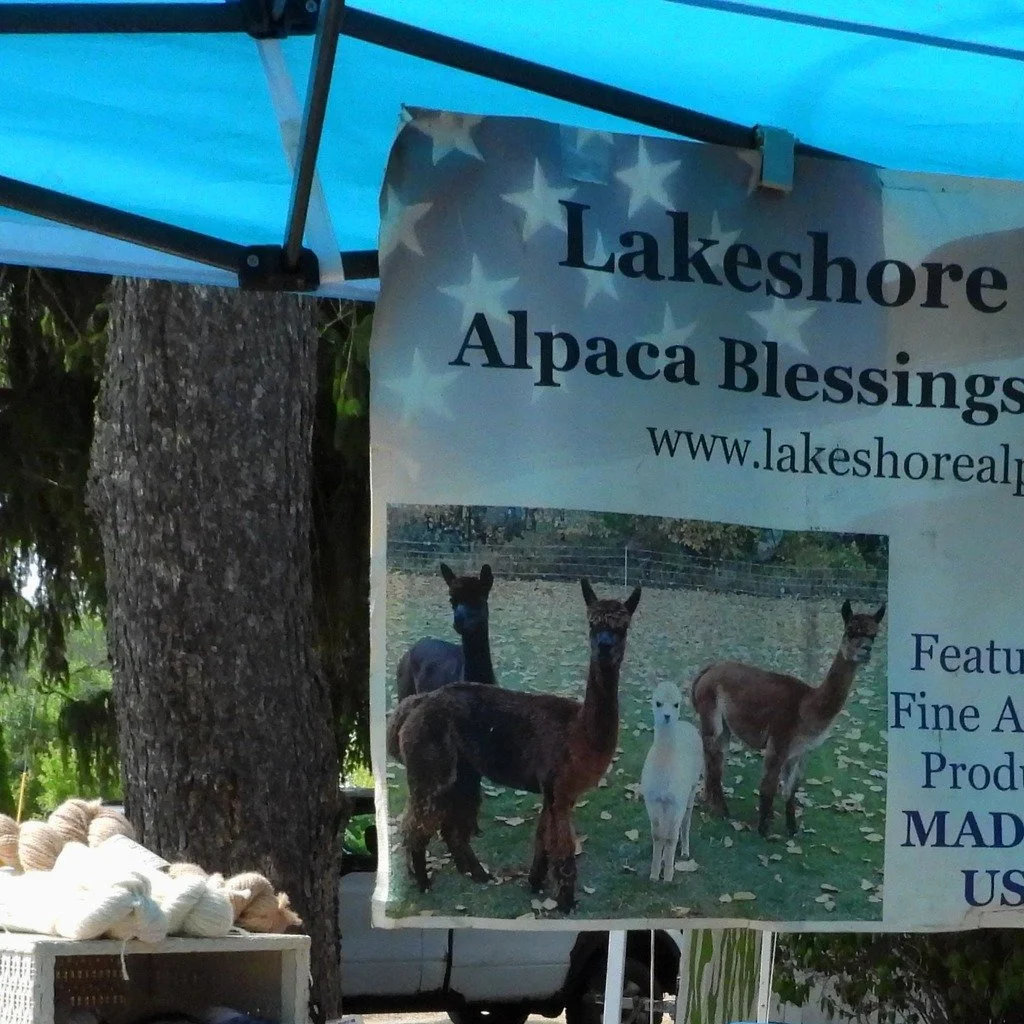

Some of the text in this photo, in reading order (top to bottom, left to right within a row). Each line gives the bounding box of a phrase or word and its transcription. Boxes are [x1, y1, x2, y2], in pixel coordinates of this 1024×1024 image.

[558, 199, 1008, 313] Lakeshore
[449, 310, 699, 388] Alpaca
[890, 691, 980, 733] Fine
